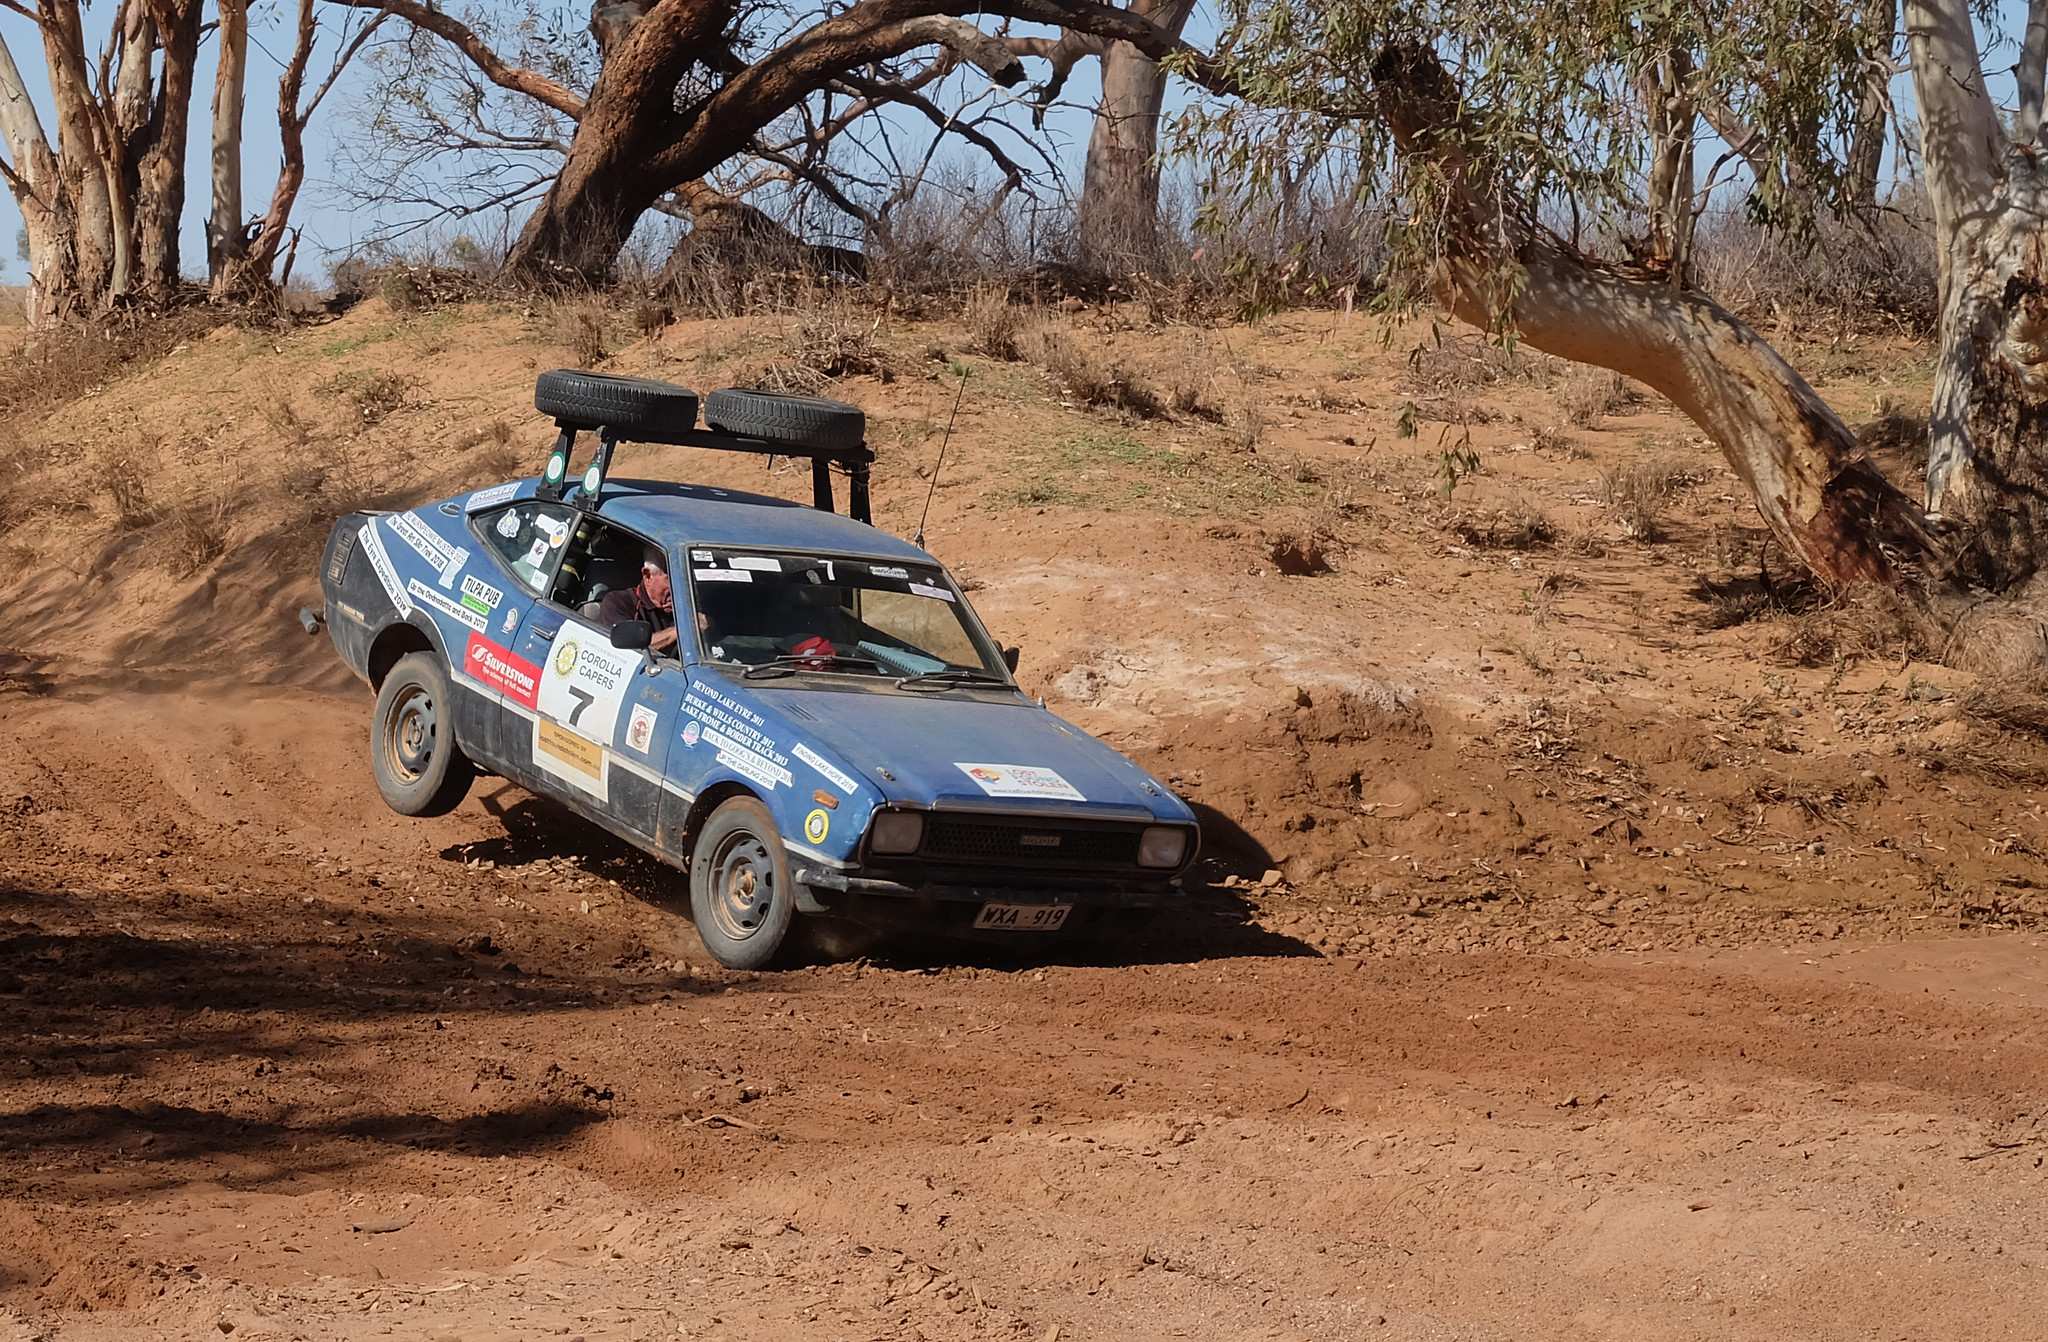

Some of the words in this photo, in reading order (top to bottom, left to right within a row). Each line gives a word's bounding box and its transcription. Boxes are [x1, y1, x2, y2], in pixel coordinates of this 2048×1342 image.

[464, 577, 485, 599] TILPA
[483, 587, 501, 609] PUB
[484, 651, 535, 691] SILVERSTONE
[578, 664, 615, 691] CAPERS
[580, 649, 623, 679] COROLLA
[568, 685, 595, 728] 7
[692, 679, 719, 702] BEYOND
[716, 692, 737, 711] LAKE
[733, 703, 753, 720] EYRE
[681, 702, 700, 720] LAKE
[697, 711, 721, 731] FROME
[726, 727, 754, 748] BORDER
[751, 740, 777, 761] TRACK
[685, 693, 707, 712] BURKE
[711, 708, 733, 726] WILLS
[731, 717, 762, 742] COUNTRY
[759, 734, 776, 749] 2012
[983, 907, 1020, 925] WXA
[1032, 909, 1065, 925] 919
